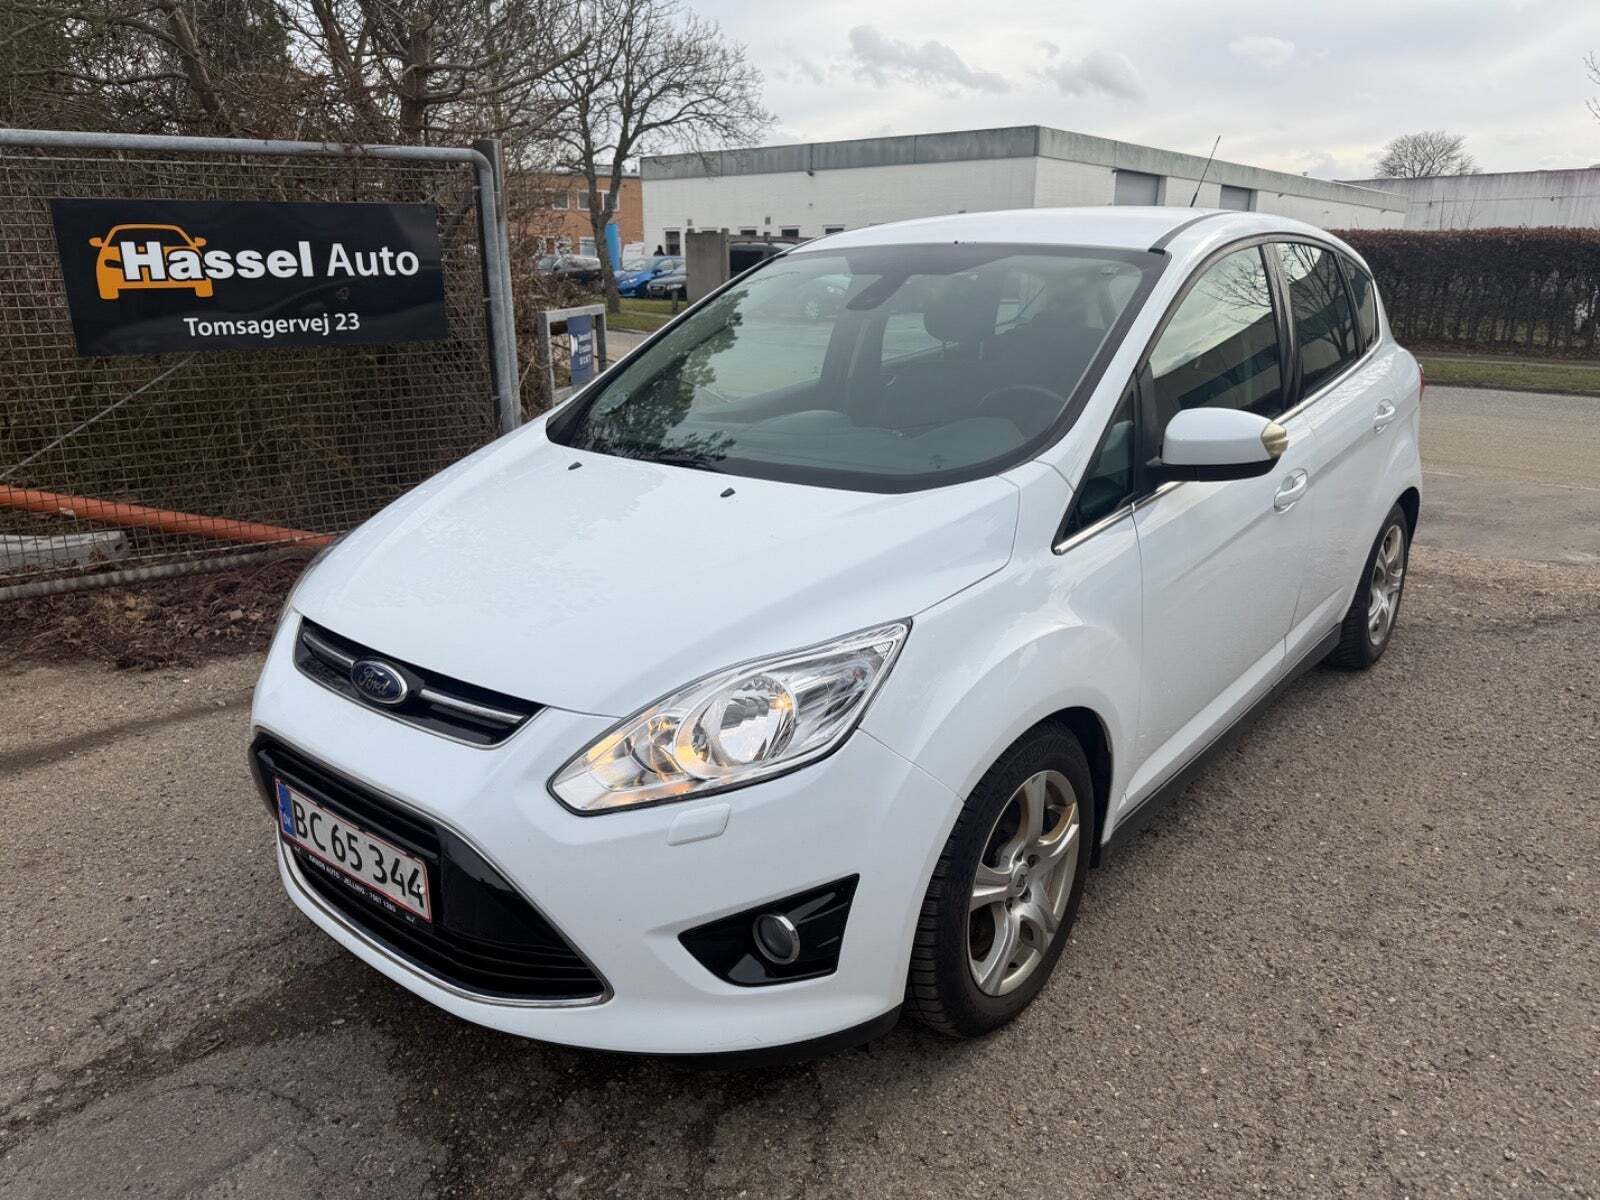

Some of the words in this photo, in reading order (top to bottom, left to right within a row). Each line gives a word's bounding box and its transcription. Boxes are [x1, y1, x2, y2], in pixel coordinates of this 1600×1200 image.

[121, 241, 313, 280] Hassel
[327, 243, 419, 277] Auto
[184, 315, 329, 338] Tomsagervej
[335, 313, 360, 330] 23
[292, 800, 326, 852] BC
[331, 824, 363, 872] 65
[369, 844, 424, 909] 344
